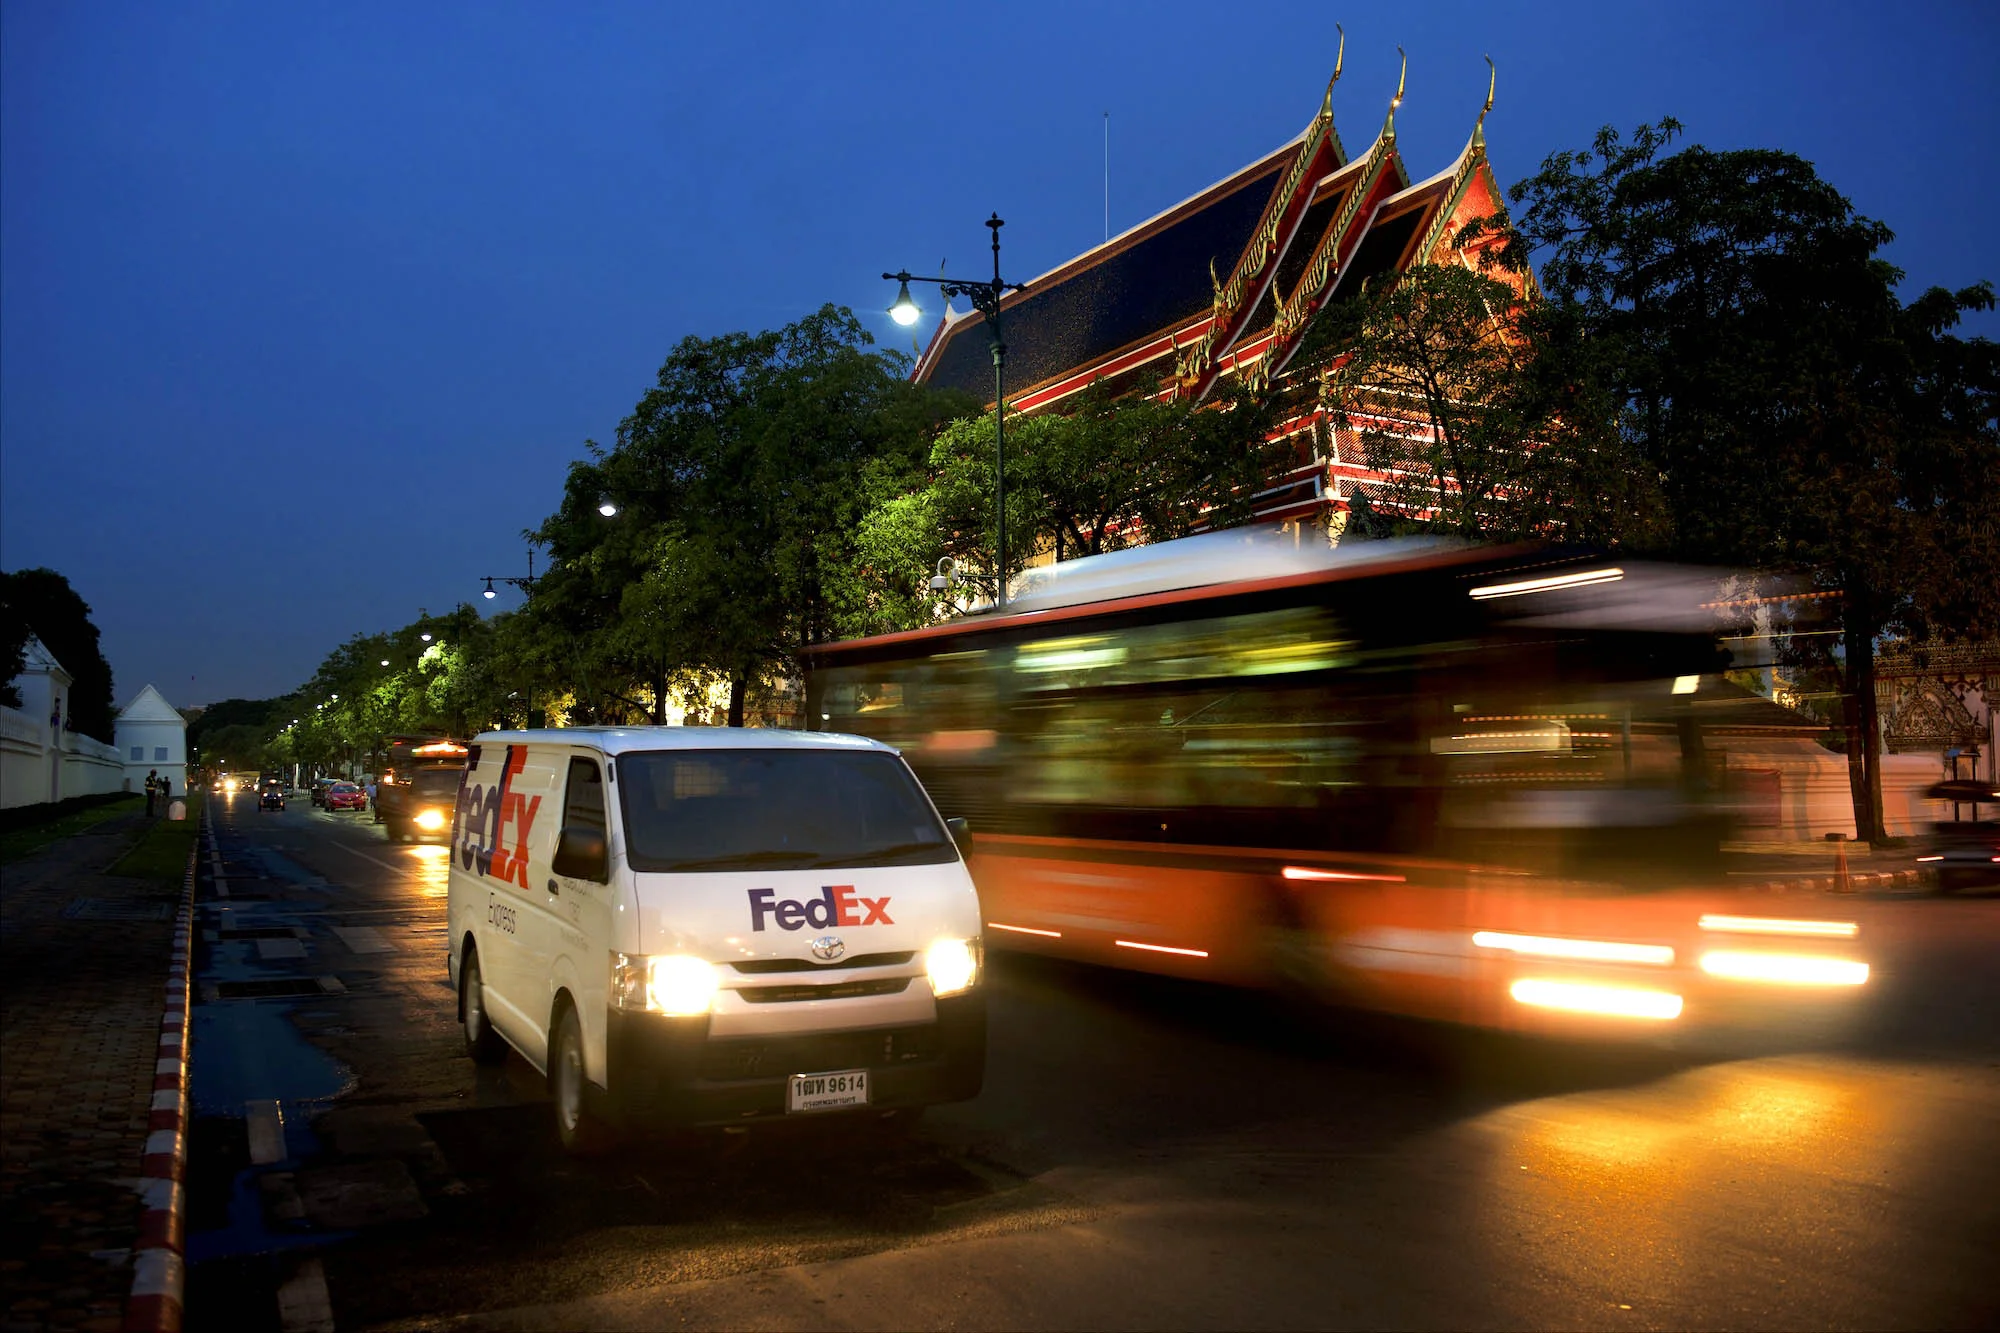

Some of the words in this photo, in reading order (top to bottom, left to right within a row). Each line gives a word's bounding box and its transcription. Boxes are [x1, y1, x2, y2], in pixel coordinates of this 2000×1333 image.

[450, 745, 543, 890] FedEx
[488, 892, 516, 934] Express
[747, 885, 895, 932] FedEx
[828, 1074, 864, 1093] 9614
